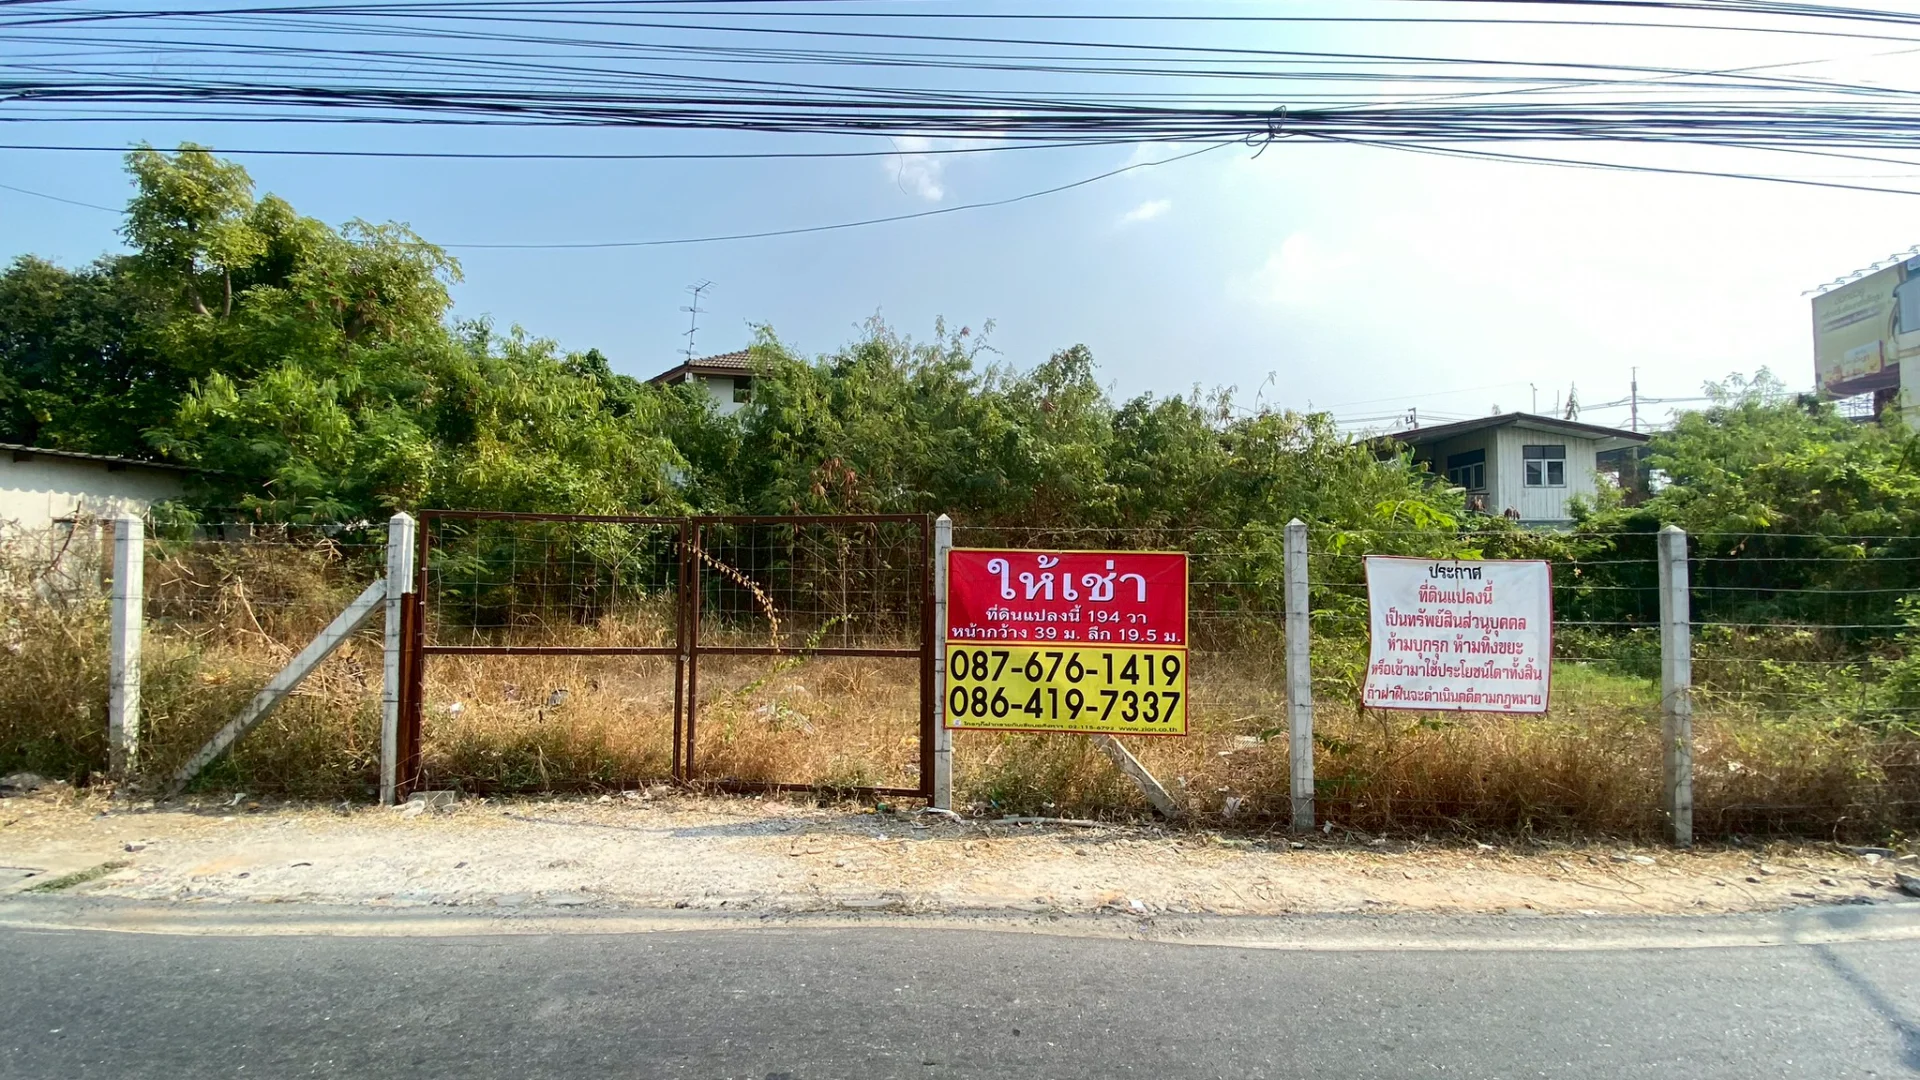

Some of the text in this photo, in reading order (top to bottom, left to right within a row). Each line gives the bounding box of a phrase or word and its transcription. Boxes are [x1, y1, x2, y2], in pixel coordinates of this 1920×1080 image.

[987, 554, 1147, 602] ให้เช่า
[1428, 563, 1482, 580] ประกาศ
[1418, 580, 1493, 605] ที่ดินแปลงนี้
[985, 605, 1147, 624] ที่ดินแปลงนี้ 194 วา
[1385, 607, 1527, 636] เป็นทรัพย์สินส่วนบุคคล
[951, 623, 1181, 642] หน้ากว้าง 39 ม. ลึก 19.5 ม.
[1387, 627, 1524, 660] ห้ามบุกรุก ห้ามทิ้งขยะ
[950, 649, 1181, 686] 087-676-1419
[949, 686, 1181, 723] 086-419-7337
